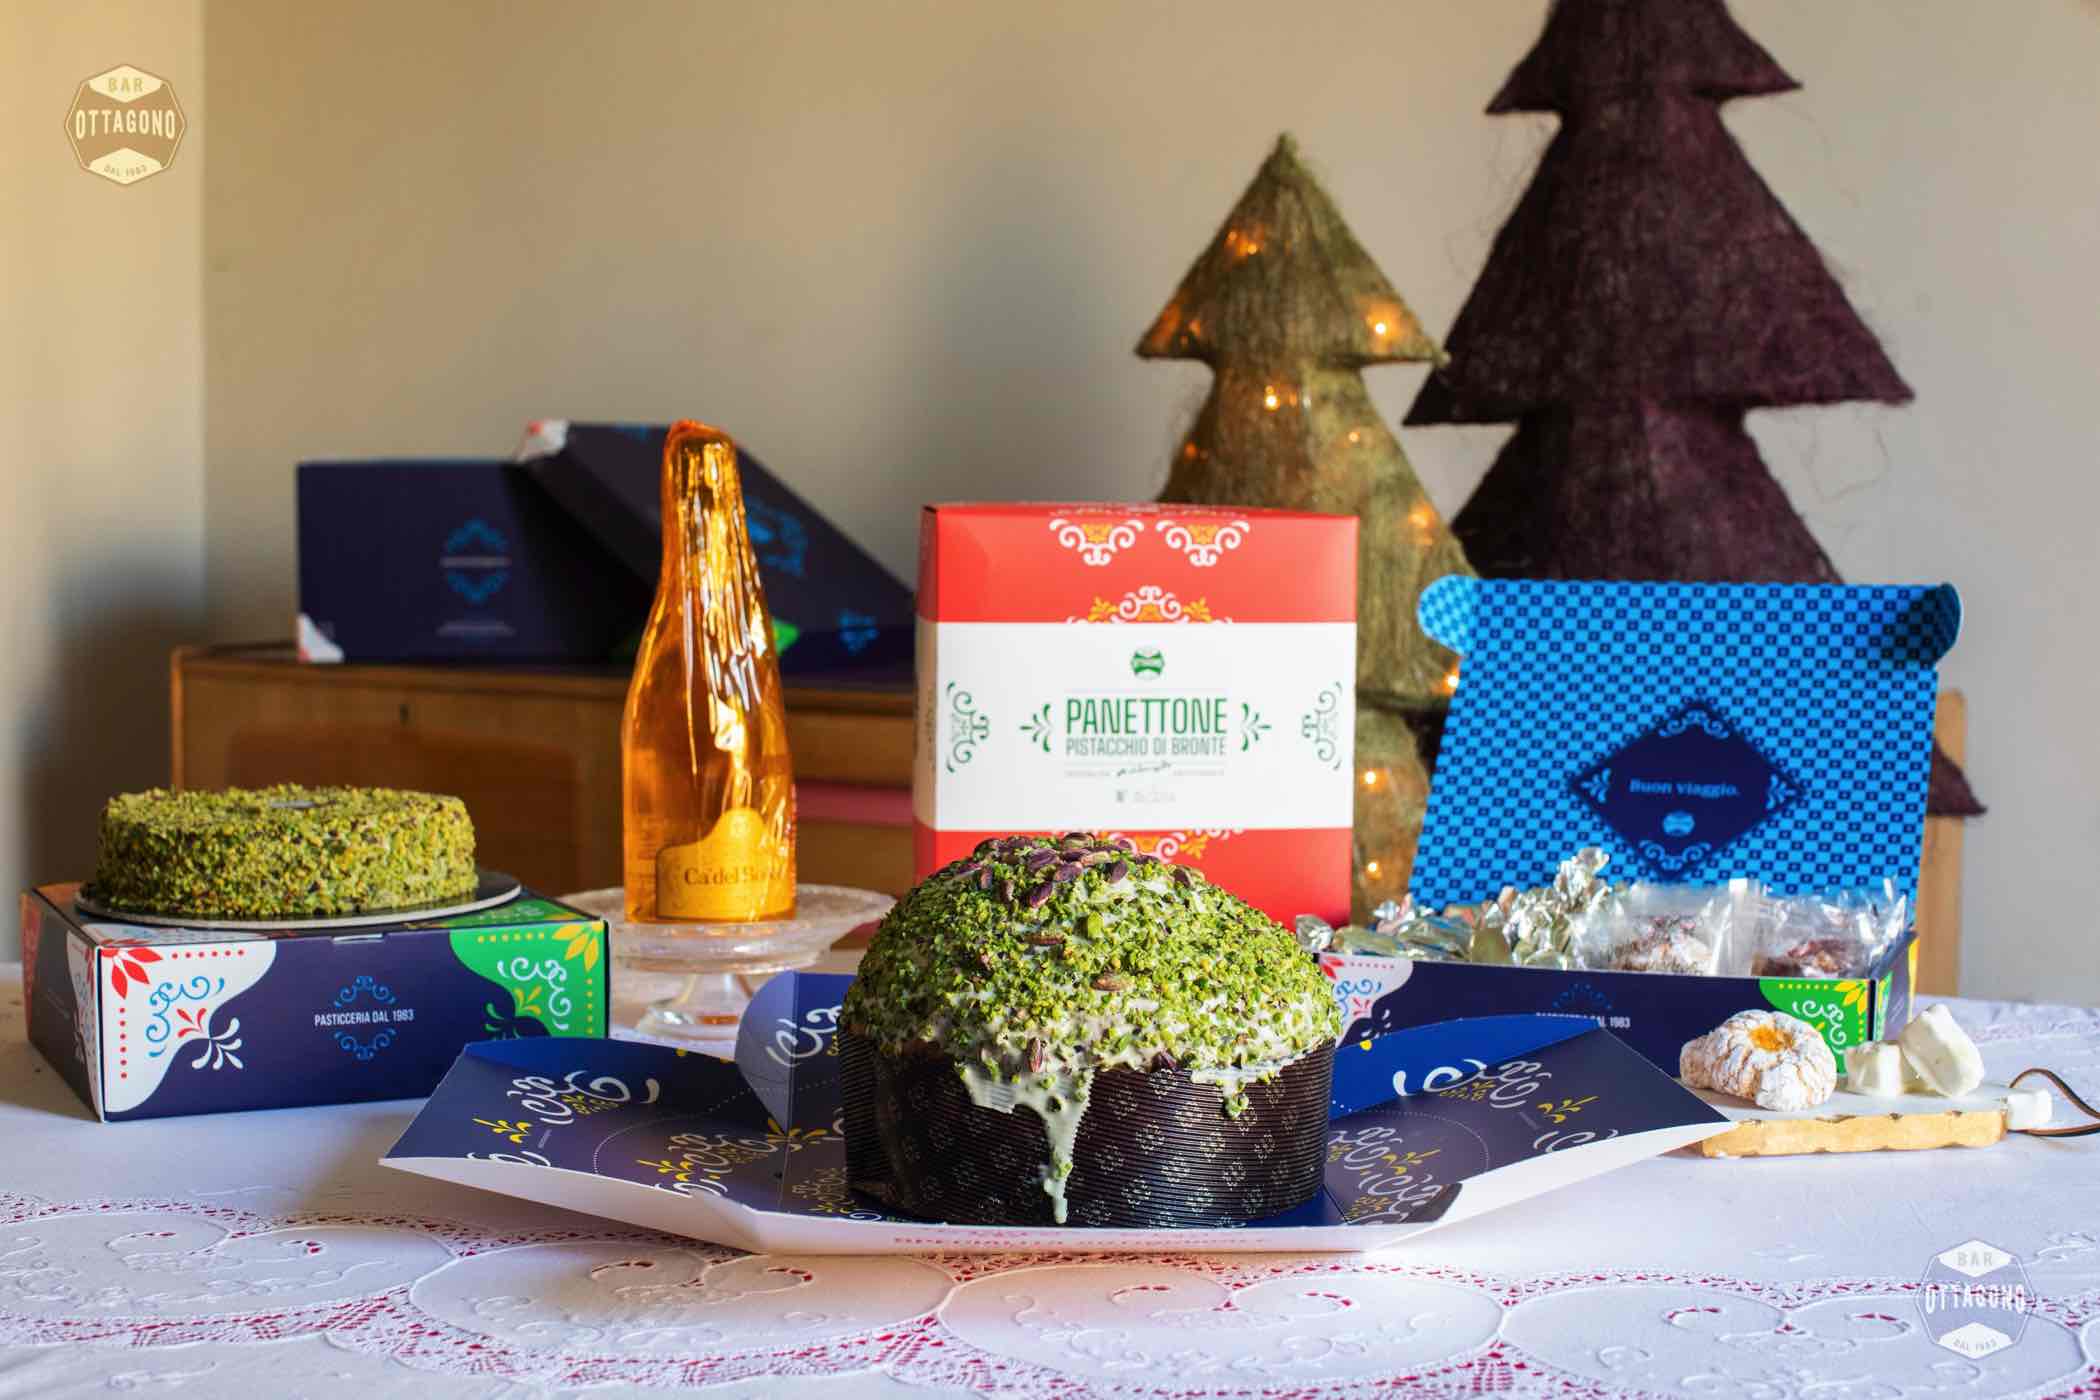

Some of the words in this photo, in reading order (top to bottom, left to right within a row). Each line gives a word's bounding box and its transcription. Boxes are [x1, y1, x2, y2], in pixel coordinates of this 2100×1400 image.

[1066, 698, 1227, 735] PANETTONE
[1065, 737, 1149, 756] PISTACCHIO
[1153, 737, 1167, 756] DI
[1171, 737, 1226, 756] BRONTE
[314, 1011, 370, 1026] PASTICCERIA
[372, 1010, 389, 1022] DAL
